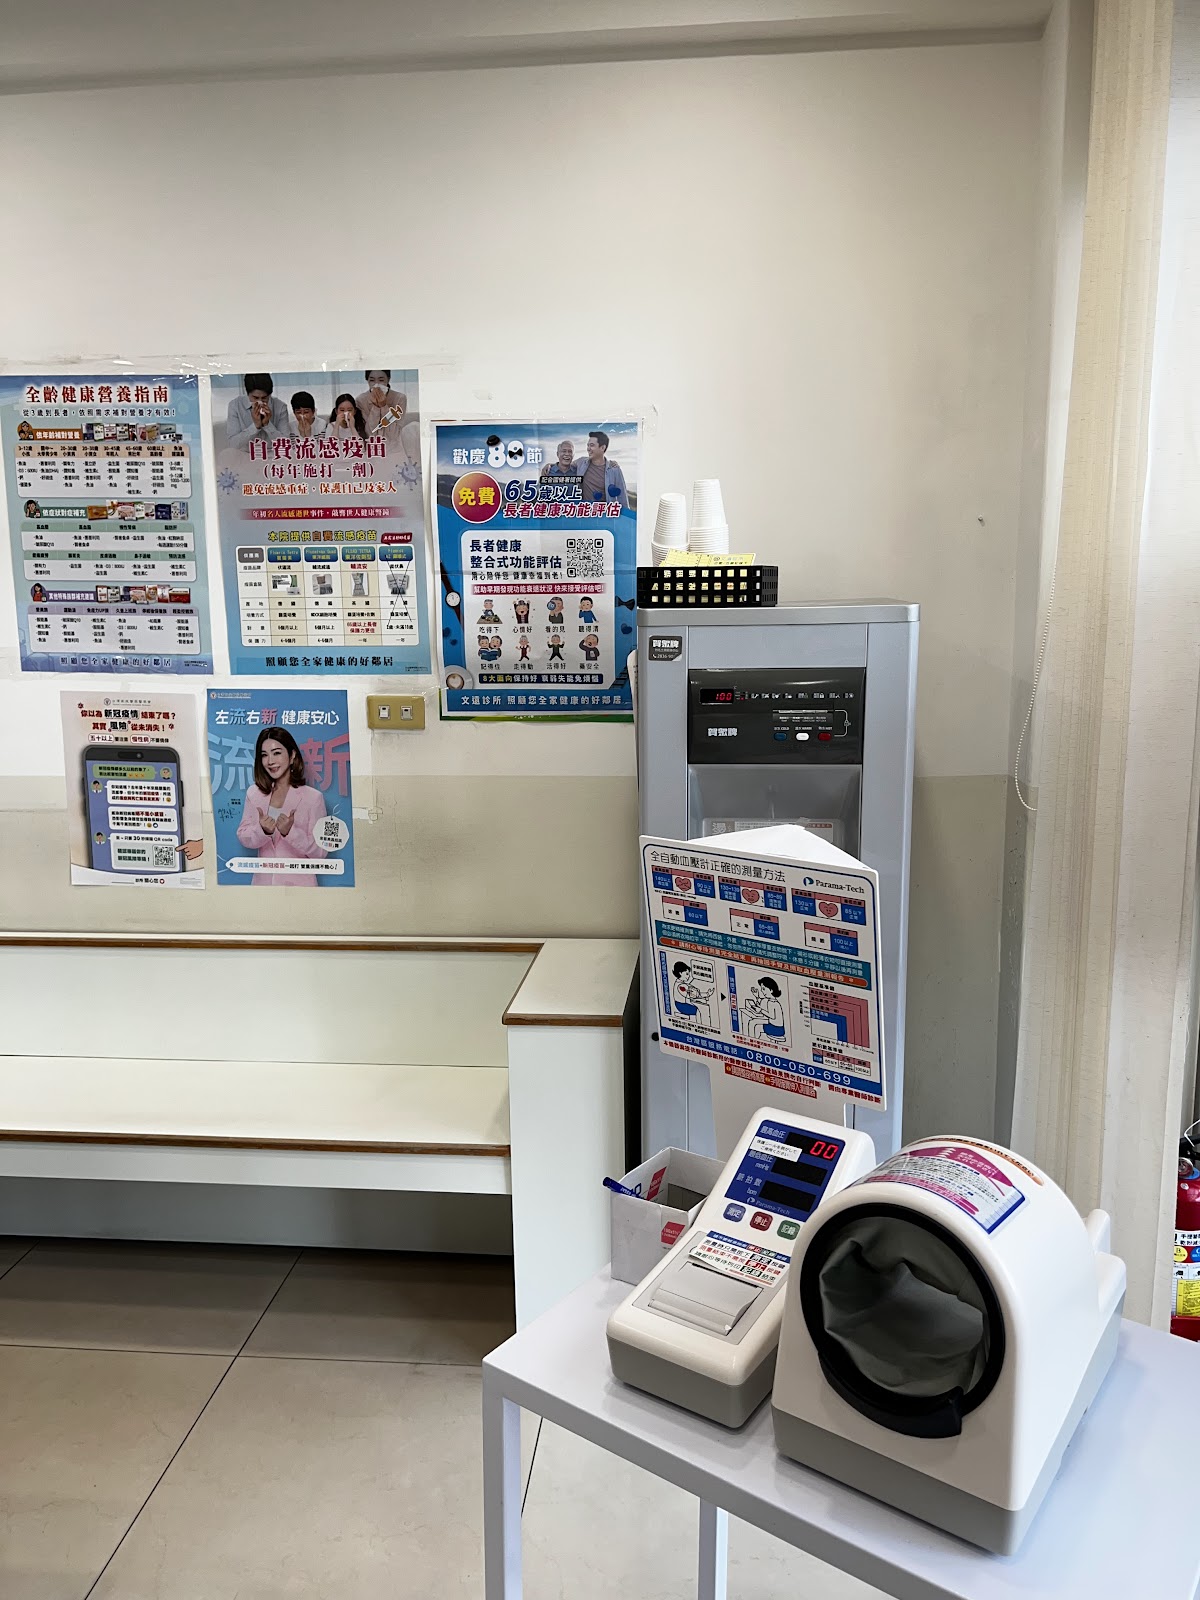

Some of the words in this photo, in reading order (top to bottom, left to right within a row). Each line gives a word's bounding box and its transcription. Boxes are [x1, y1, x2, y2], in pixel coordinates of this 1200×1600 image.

[25, 385, 169, 403] 全齡健康營養指南
[249, 436, 387, 461] 自費流感疫苗
[452, 440, 543, 468] 歡慶88節
[263, 463, 374, 479] (每年施打一劑)
[458, 487, 496, 506] 免費
[505, 479, 583, 502] 65歲以上
[503, 502, 621, 519] 長者健康功能評估
[268, 529, 377, 542] 本院提供自費流感疫苗
[469, 539, 522, 553] 長者健康
[470, 555, 562, 569] 整合式功能評估
[479, 626, 500, 634] 吃得下
[511, 626, 533, 634] 心情好
[60, 656, 171, 667] 照顧您全家健康的好鄰居
[265, 656, 394, 667] 照顧您全家健康的好鄰居
[546, 662, 567, 670] 活得好
[579, 662, 600, 670] 藥安全
[482, 674, 538, 683] 8大面向保持好
[507, 695, 622, 705] 照顧您全家健康的好鄰居
[715, 692, 733, 701] 100
[80, 710, 103, 718] 你以為
[103, 709, 139, 719] 新冠疫情
[140, 711, 176, 720] 結束了嗎？
[215, 707, 278, 726] 左流右新
[281, 710, 340, 726] 健康安心
[92, 722, 107, 731] 其實
[110, 721, 128, 730] 風險
[130, 723, 165, 731] 從未消失！
[207, 731, 255, 796] 流
[651, 850, 786, 882] 全自動血壓計正確的測量方法
[815, 879, 865, 894] Parama-Tech
[794, 899, 813, 907] 130以下
[688, 911, 704, 919] 60以下
[834, 937, 854, 946] 100以上
[746, 1050, 851, 1085] 0800-050-699
[810, 1141, 839, 1160] 00
[755, 1201, 791, 1216] Parama-Tech
[753, 1216, 768, 1227] 停止
